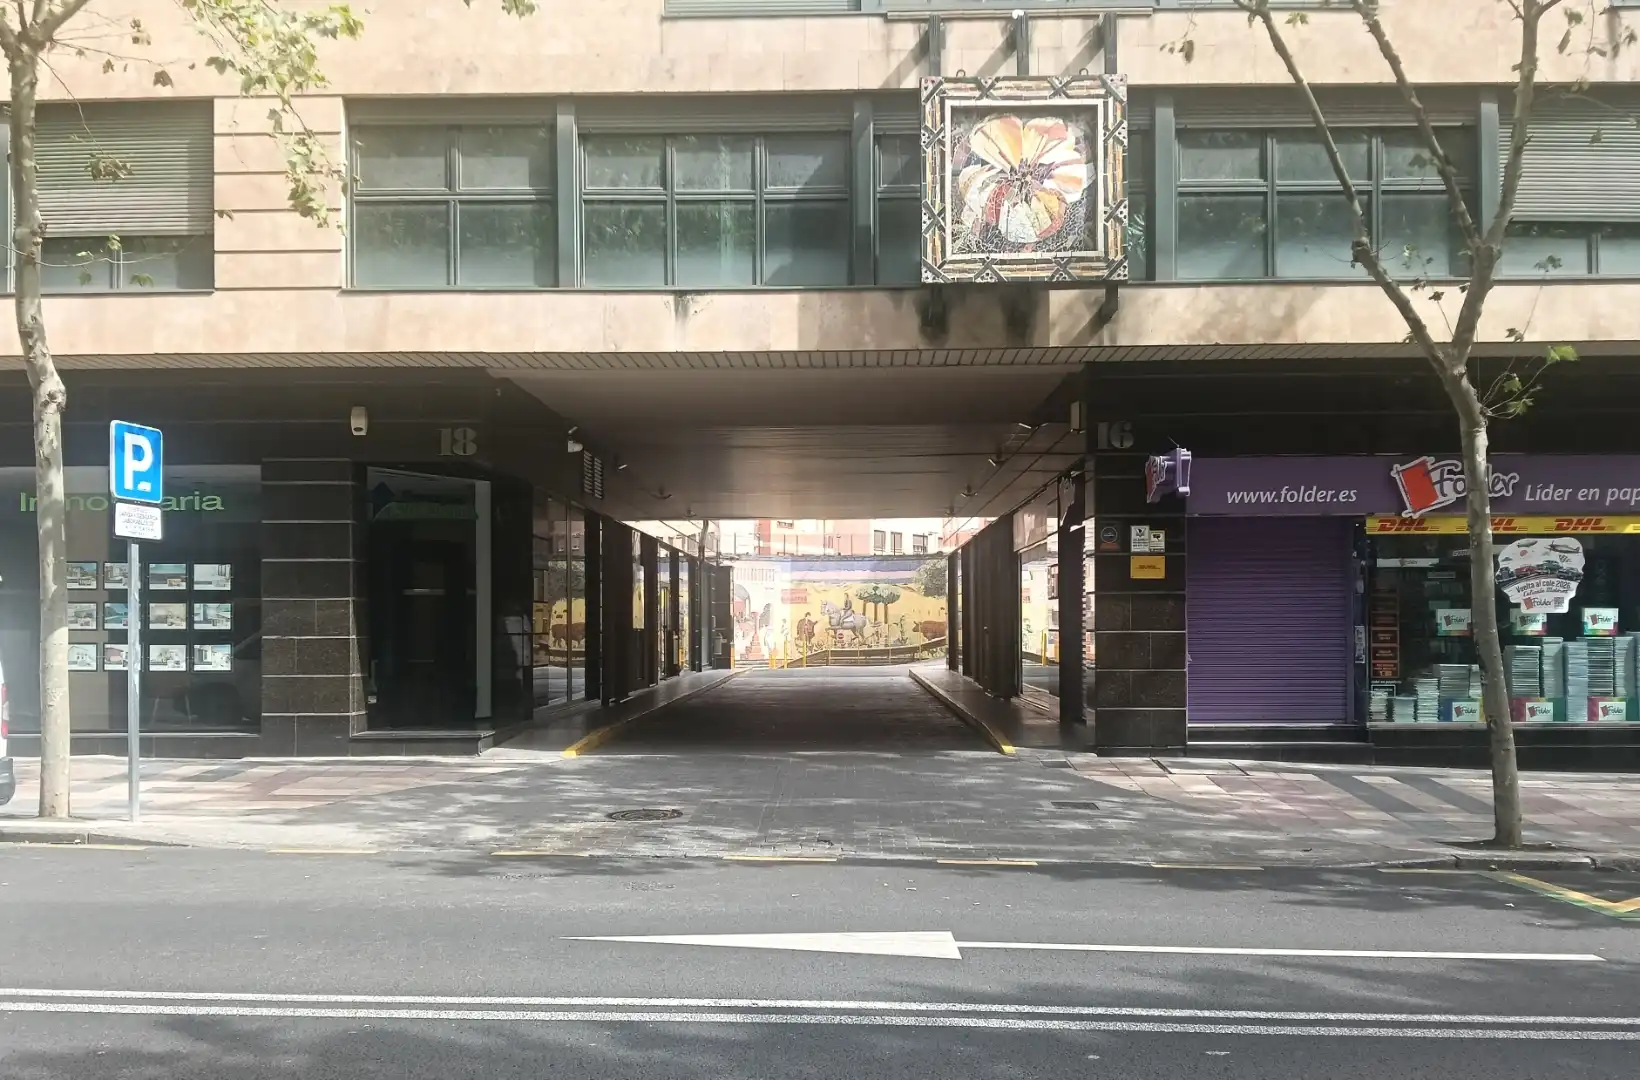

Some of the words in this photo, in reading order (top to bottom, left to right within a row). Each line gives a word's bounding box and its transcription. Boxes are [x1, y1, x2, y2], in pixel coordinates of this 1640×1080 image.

[436, 427, 477, 456] 18
[1097, 421, 1134, 449] 16
[124, 432, 153, 490] P
[1425, 460, 1519, 497] Foer
[1227, 485, 1357, 504] www.folder.es
[1525, 483, 1573, 501] Líder
[1579, 487, 1599, 501] en
[1606, 488, 1640, 506] pap
[1377, 518, 1429, 532] DHL
[1554, 518, 1606, 531] DHL
[1515, 581, 1535, 593] Vuelta
[1535, 580, 1541, 588] al
[1532, 597, 1553, 606] Folder
[1597, 614, 1612, 623] Folder
[1535, 706, 1551, 714] Folder
[1608, 706, 1624, 714] Folder
